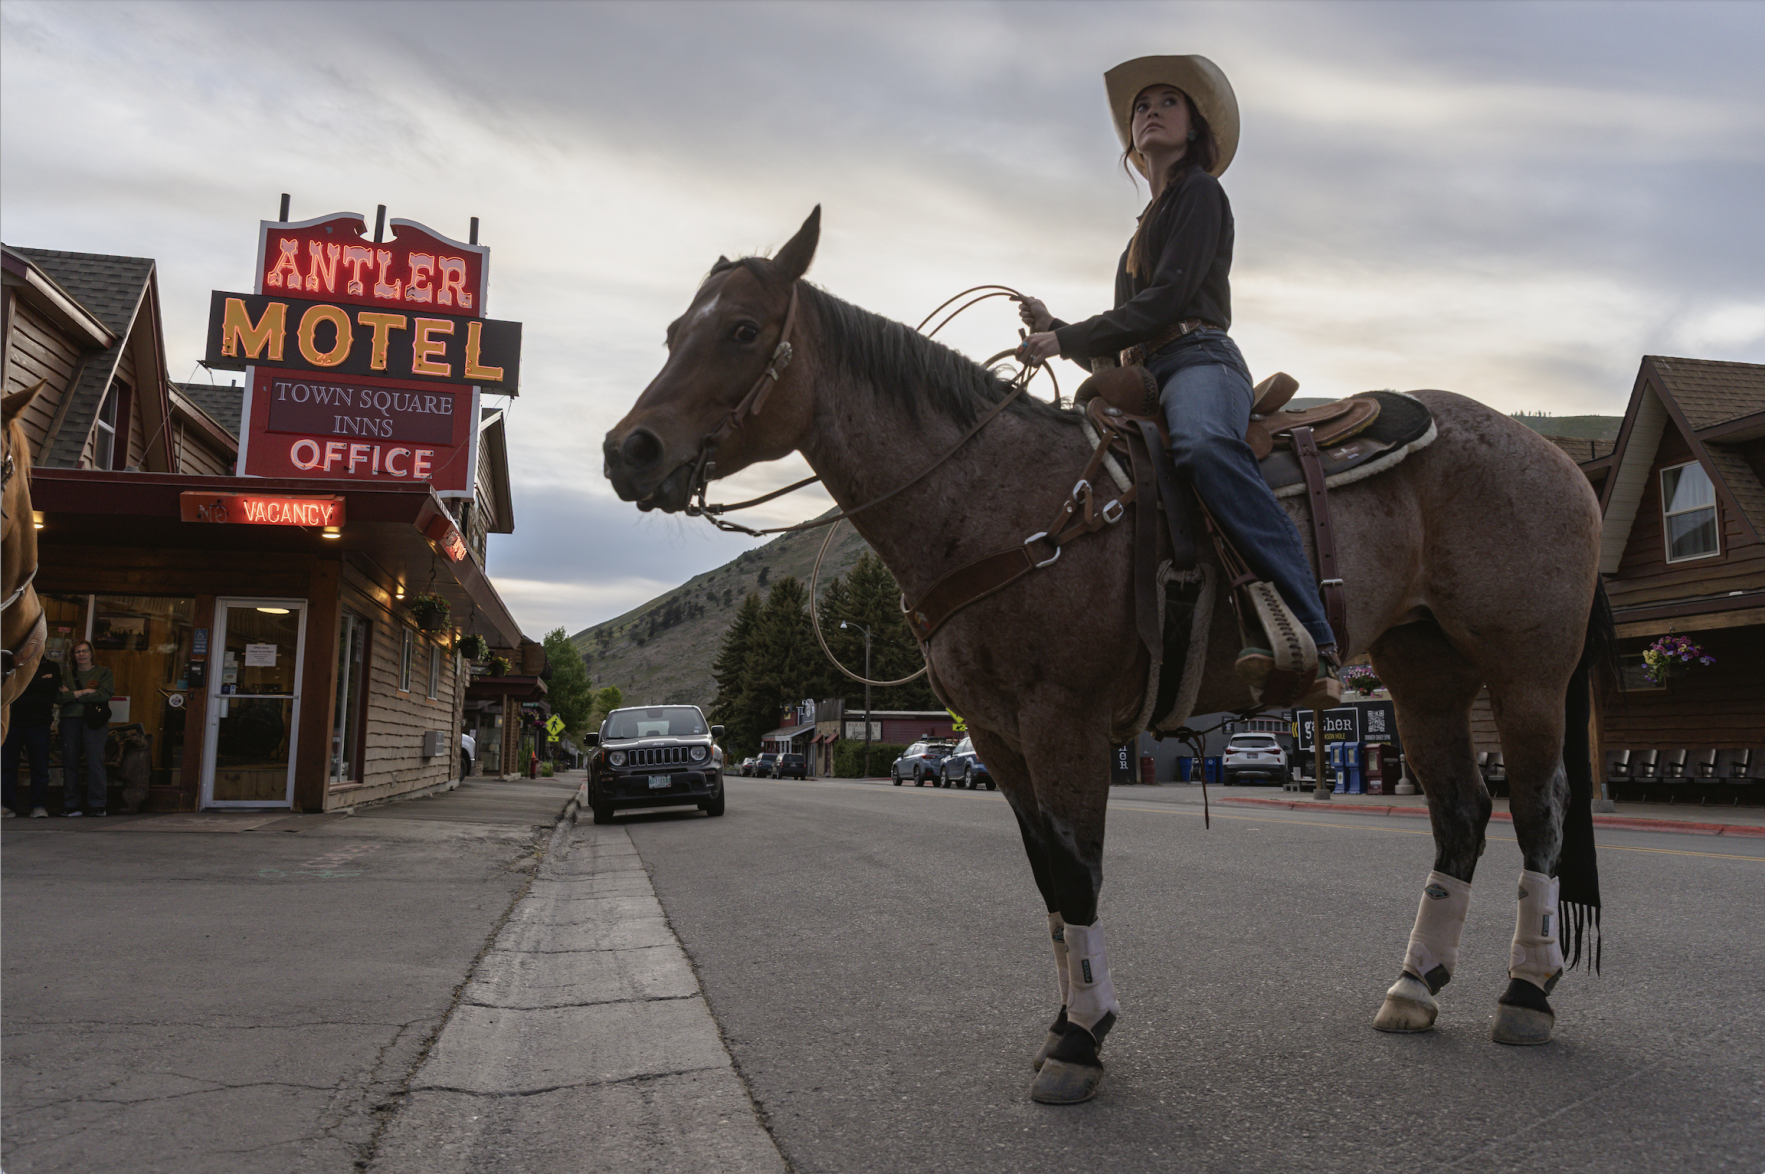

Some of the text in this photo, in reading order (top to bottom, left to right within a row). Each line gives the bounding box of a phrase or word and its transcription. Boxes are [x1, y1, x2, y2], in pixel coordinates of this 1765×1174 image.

[267, 238, 472, 308] ANTLER
[221, 298, 503, 381] MOTEL
[275, 382, 453, 416] TOWN SQUARE
[332, 415, 393, 437] INNS
[290, 439, 434, 478] OFFICE
[198, 500, 334, 526] NO VACANCY
[1304, 717, 1352, 739] gheR
